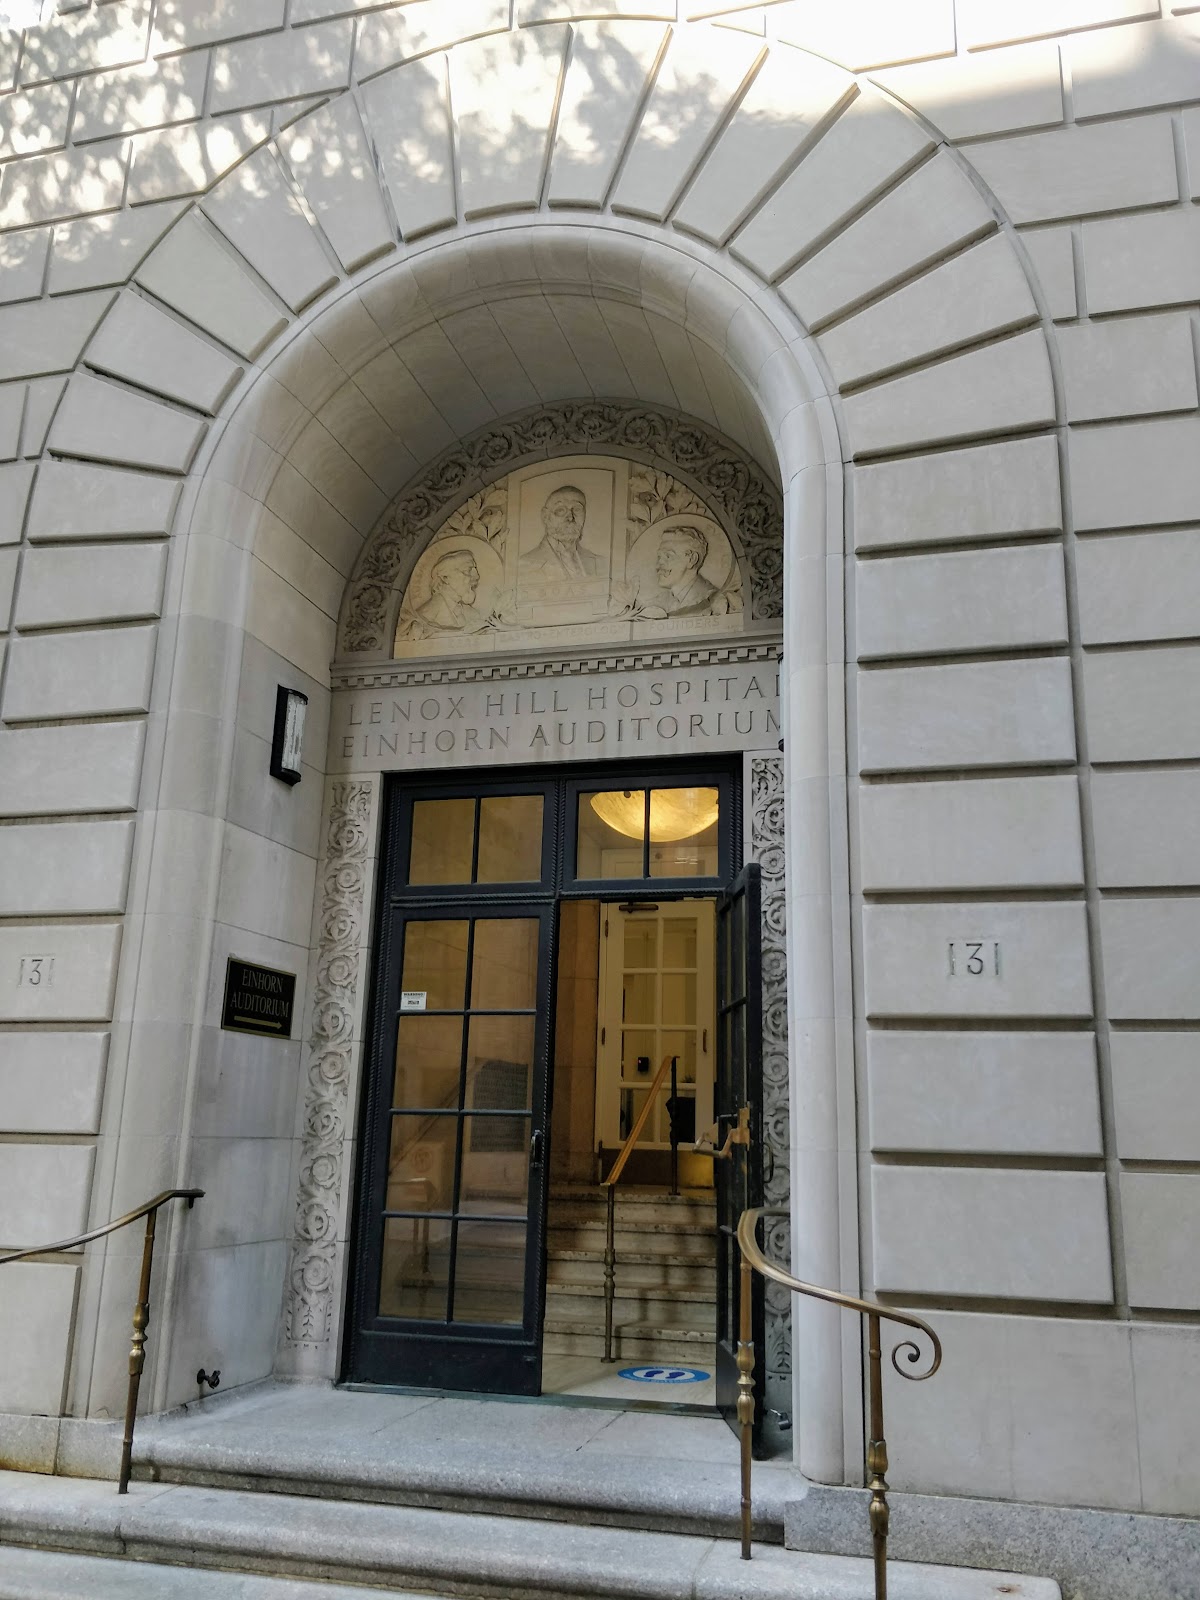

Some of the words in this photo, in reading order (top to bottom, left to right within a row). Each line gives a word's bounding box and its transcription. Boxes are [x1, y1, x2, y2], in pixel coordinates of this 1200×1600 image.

[649, 617, 719, 631] FOUNDERS
[348, 696, 464, 725] LENOX
[484, 688, 569, 717] HILL
[342, 726, 511, 758] EINHORN
[19, 958, 55, 985] 131
[948, 942, 999, 975] 131
[242, 969, 284, 993] EINHORN
[230, 991, 289, 1018] AUDITORIUM
